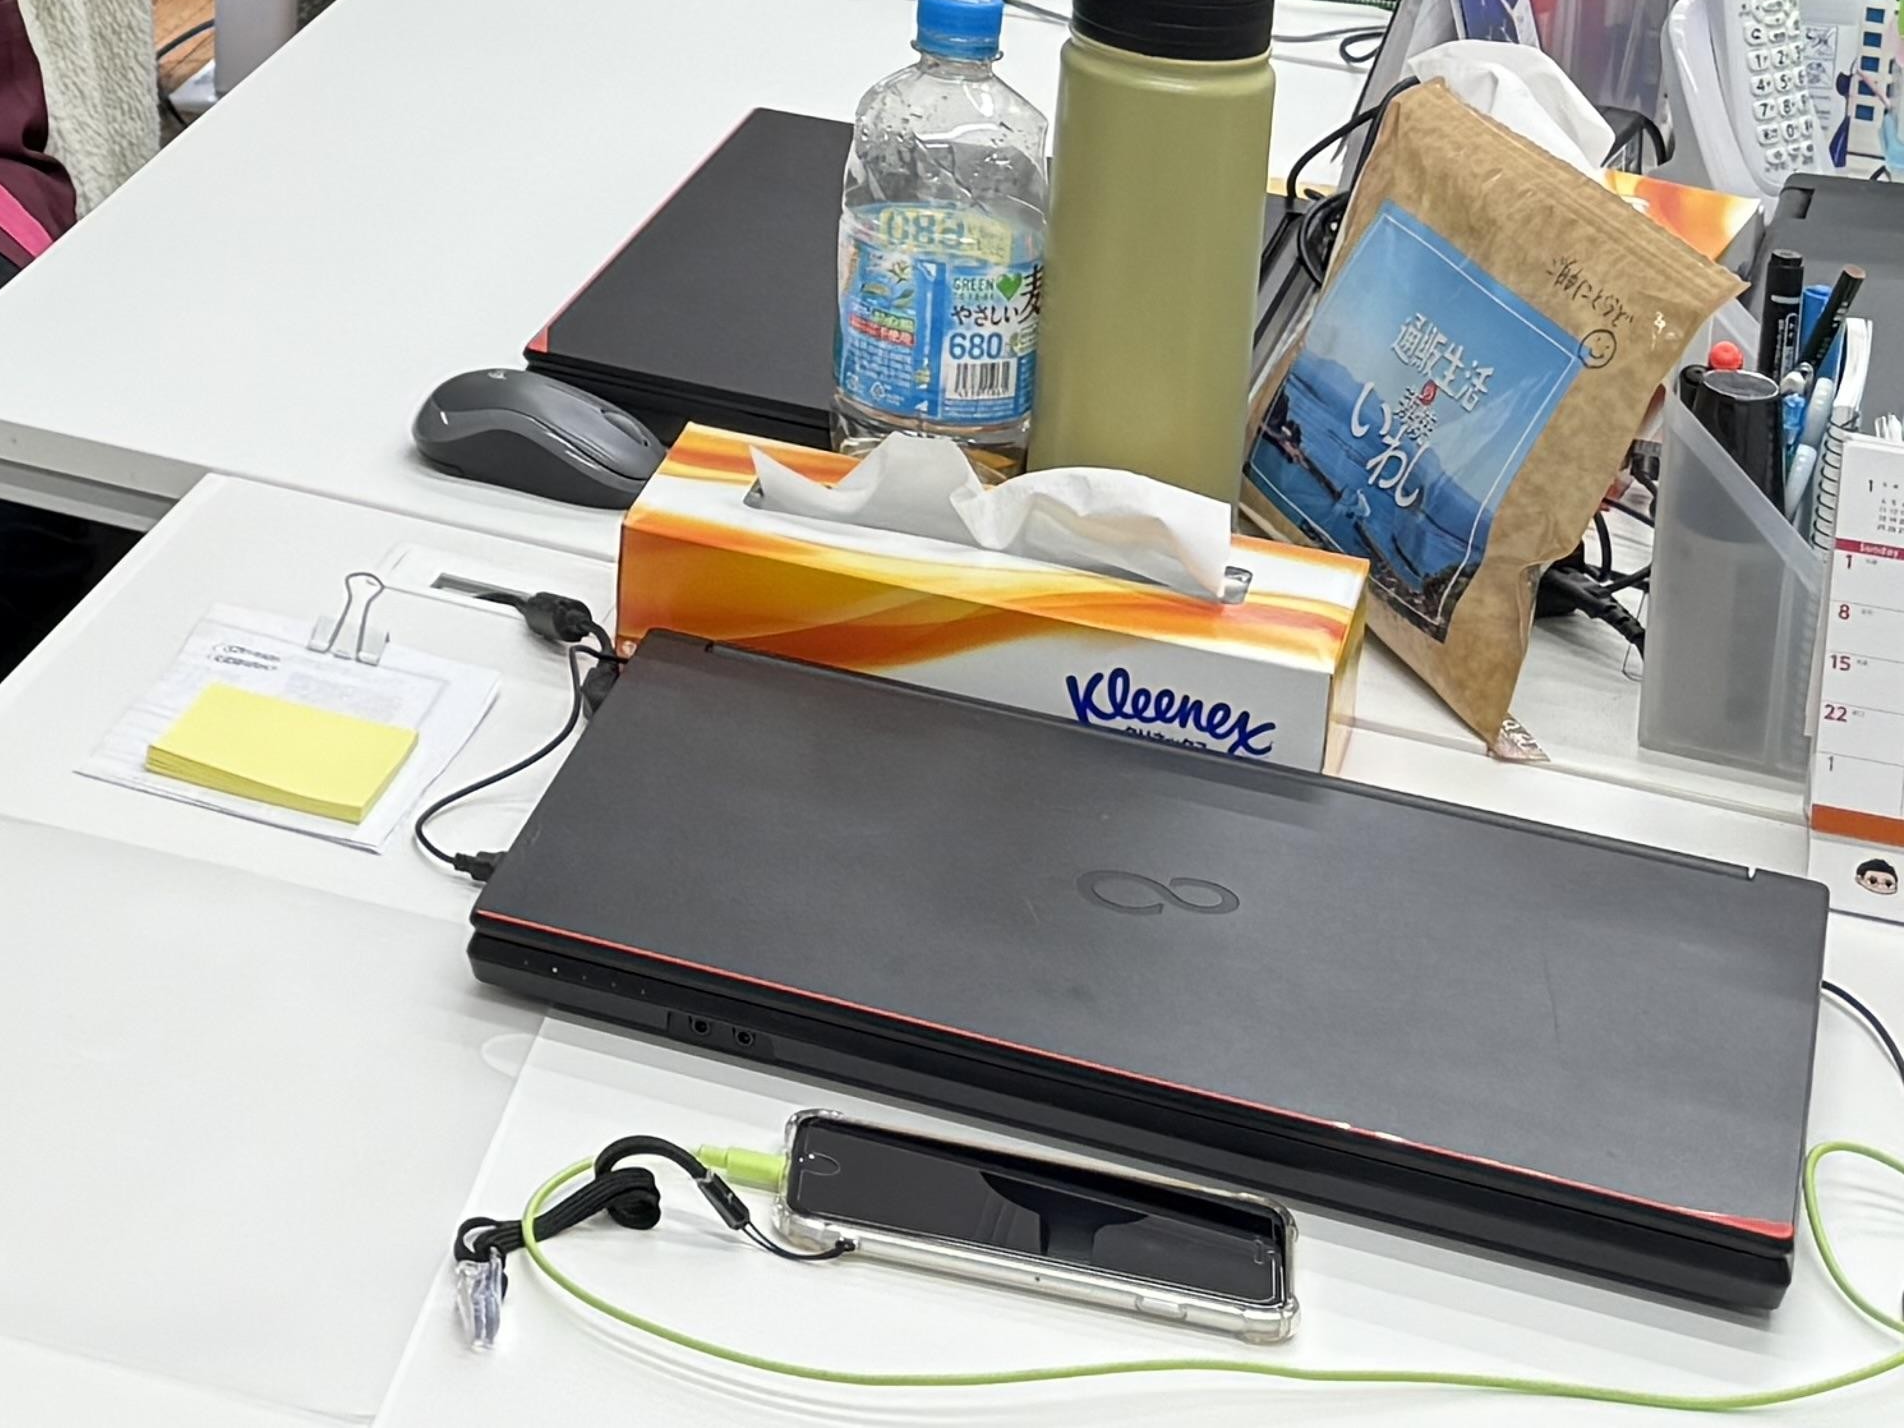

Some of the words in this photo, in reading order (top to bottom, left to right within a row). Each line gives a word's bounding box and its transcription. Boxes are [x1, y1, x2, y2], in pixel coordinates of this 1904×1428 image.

[953, 277, 994, 291] GREEN
[951, 304, 1019, 326] やさしい
[949, 332, 1003, 360] 680
[1391, 312, 1495, 413] 通販生活
[1351, 381, 1430, 507] いわし
[1838, 604, 1850, 620] 8
[1830, 654, 1852, 671] 15
[1065, 667, 1276, 756] Kleenex
[1824, 703, 1849, 722] 22
